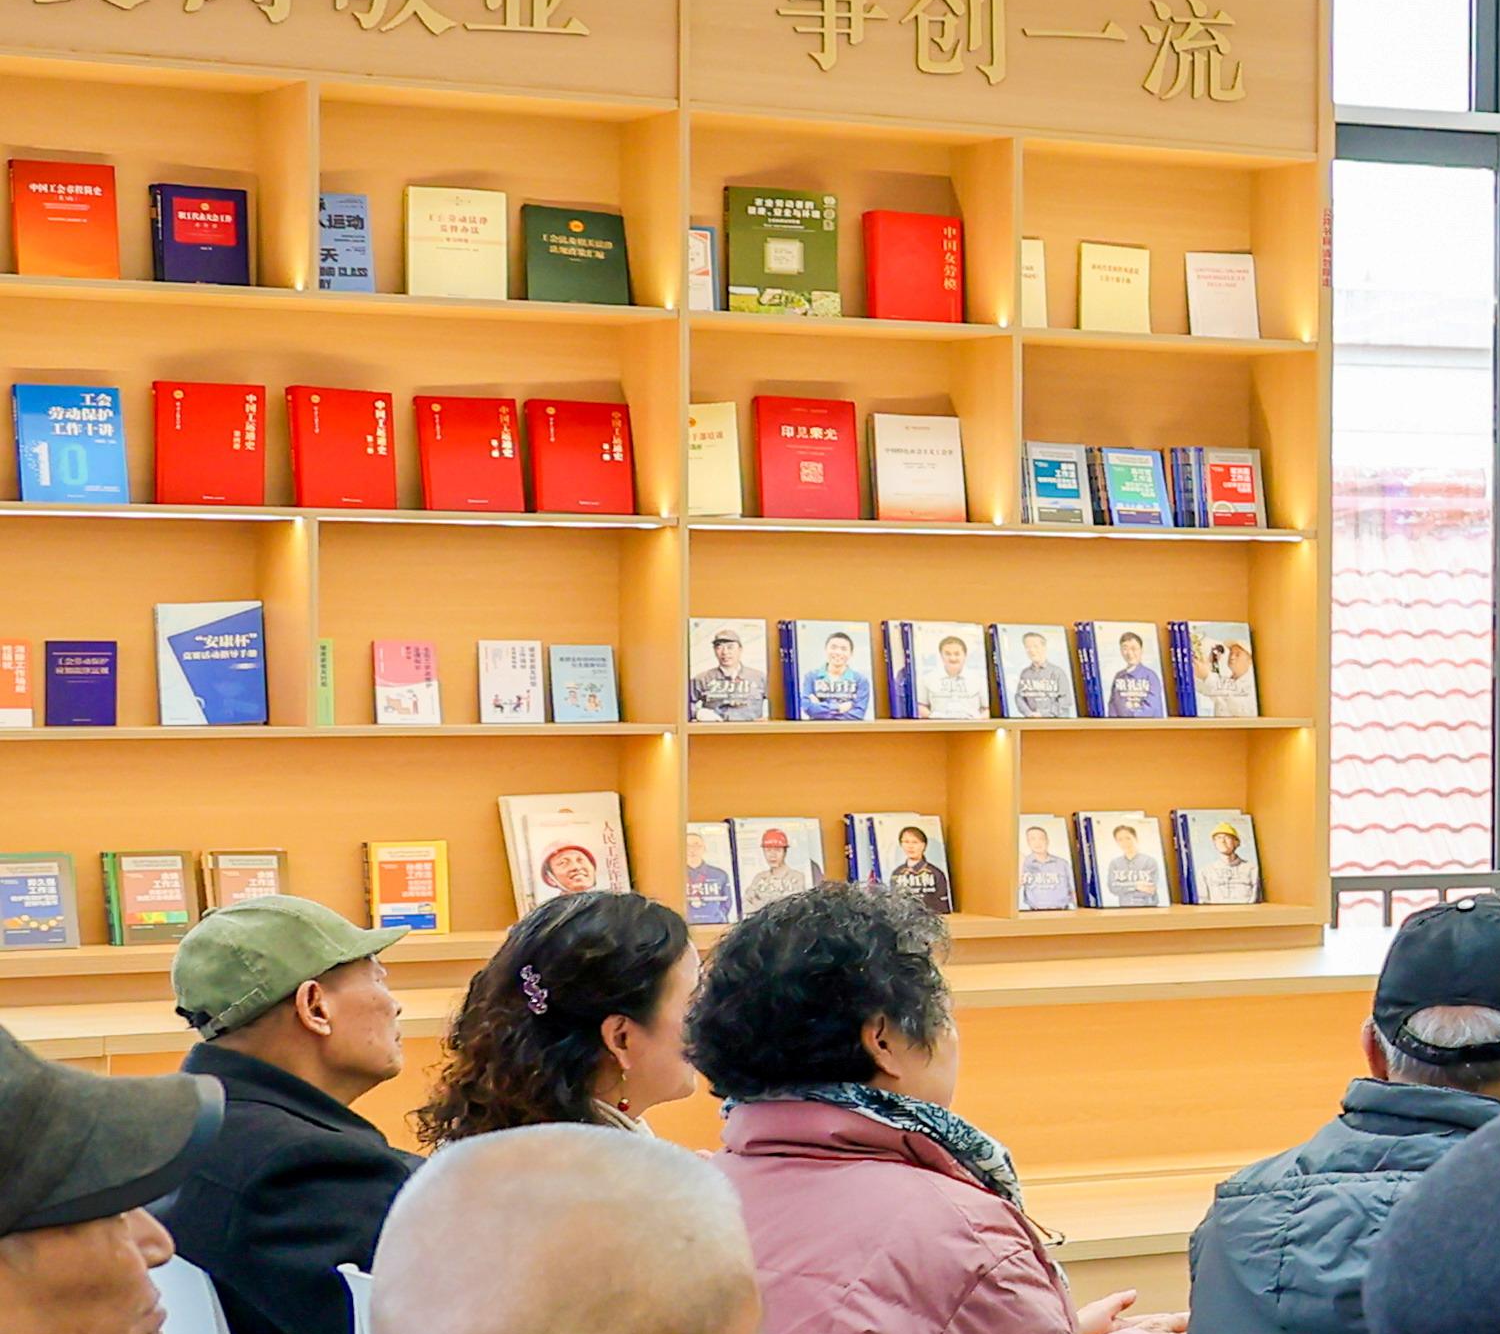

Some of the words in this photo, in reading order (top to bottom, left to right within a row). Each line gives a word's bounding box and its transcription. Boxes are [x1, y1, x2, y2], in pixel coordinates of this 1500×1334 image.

[943, 226, 957, 291] 中国女劳模
[80, 393, 113, 407] 工会
[48, 407, 114, 421] 劳动保护
[52, 421, 115, 437] 工作十讲
[28, 886, 58, 896] 工作法
